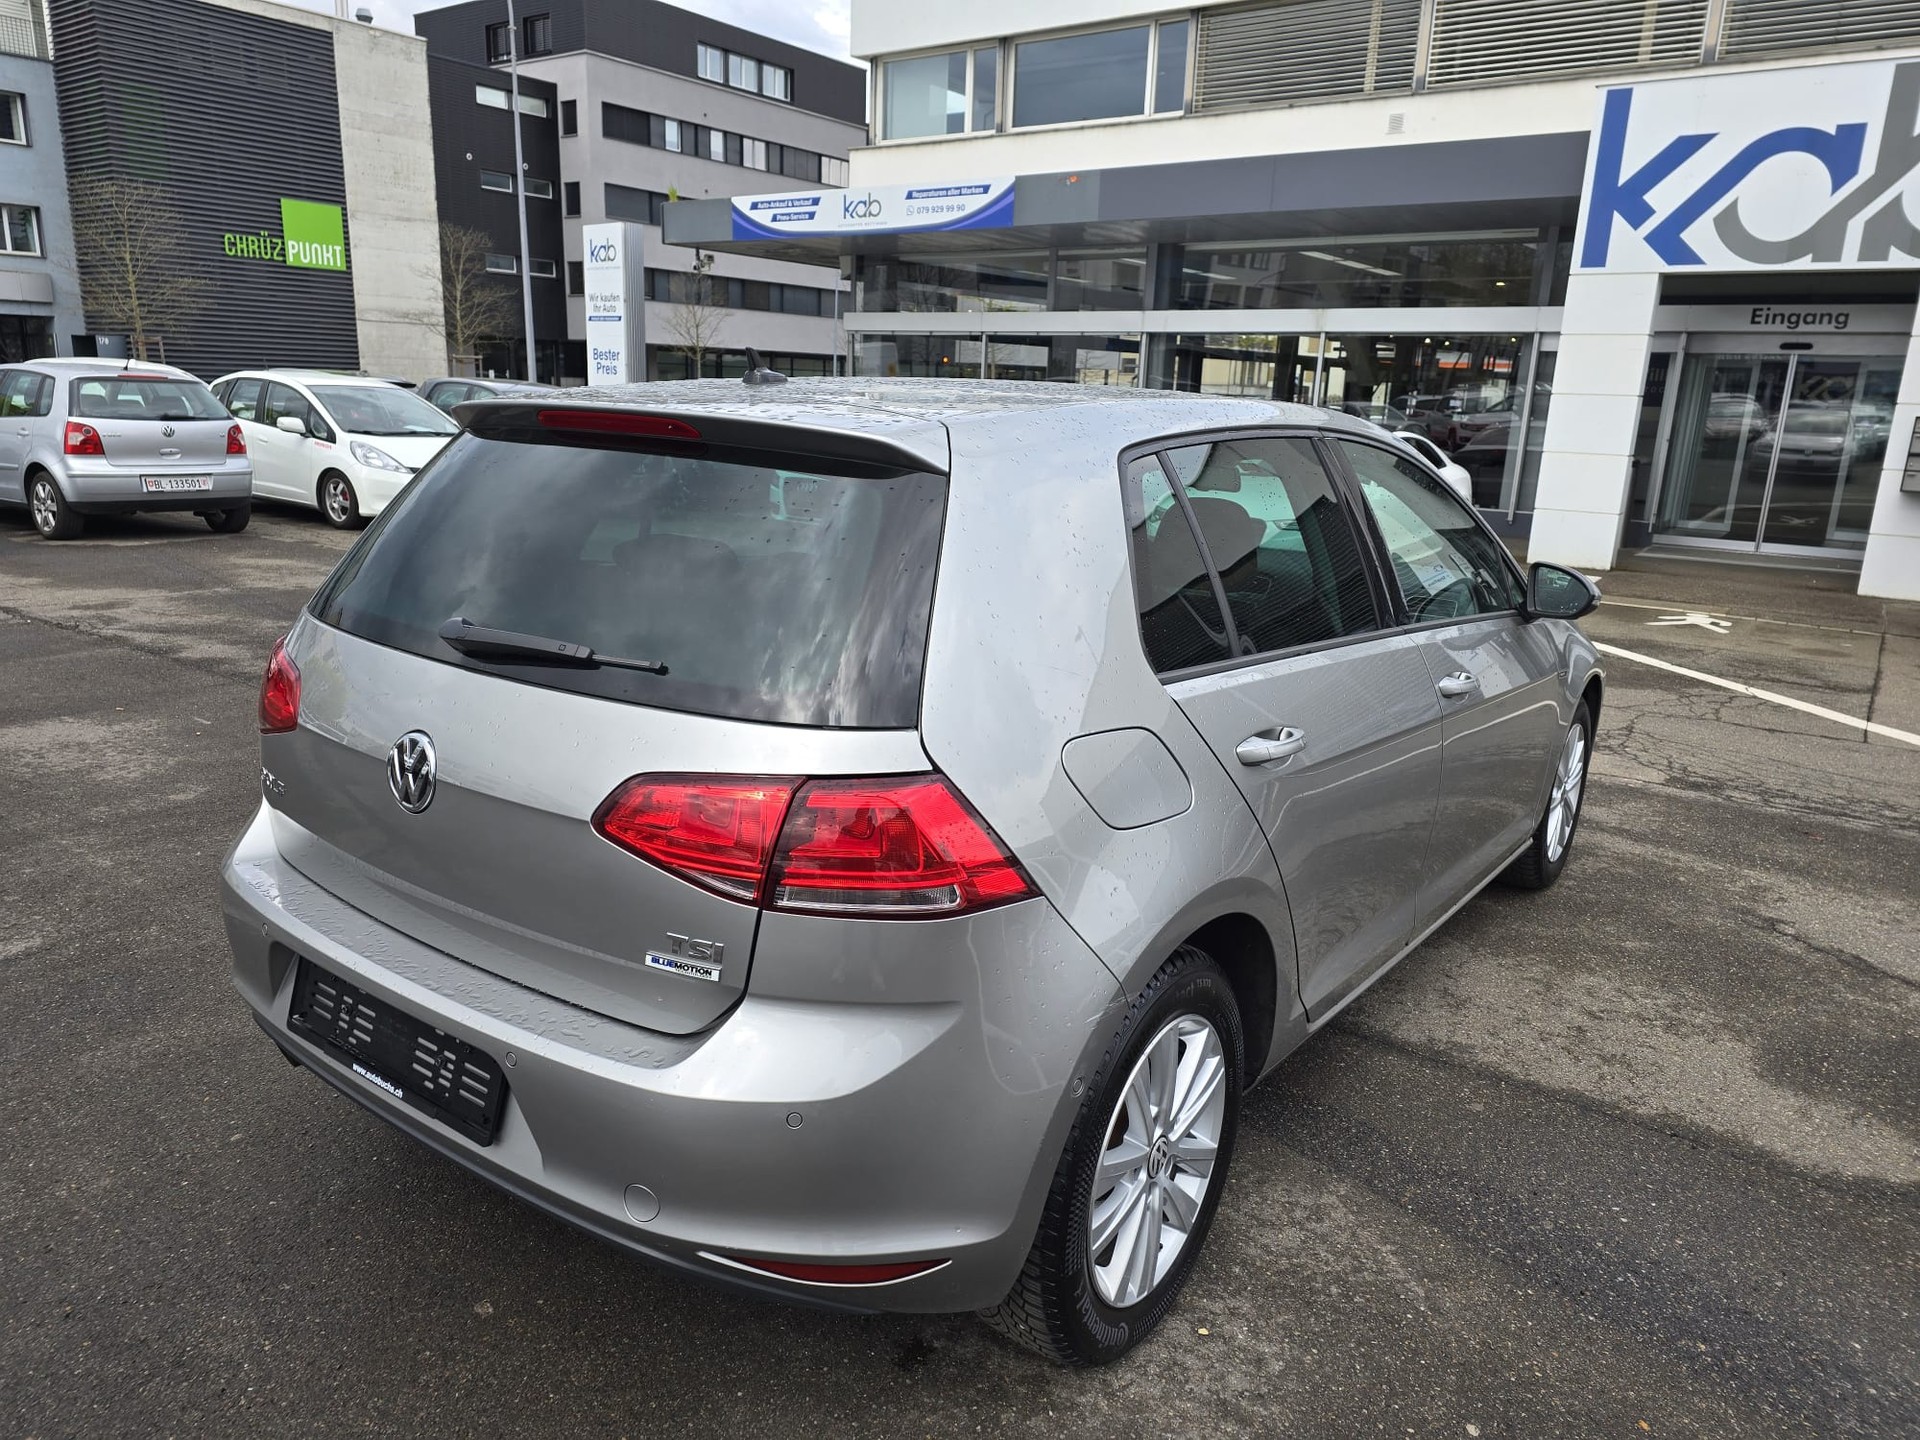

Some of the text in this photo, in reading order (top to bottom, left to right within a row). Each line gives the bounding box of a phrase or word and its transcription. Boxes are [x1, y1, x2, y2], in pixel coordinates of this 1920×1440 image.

[843, 192, 882, 220] kab
[917, 203, 966, 214] 079 929 99 90
[224, 231, 341, 267] CHRÜZ PUNKT
[590, 238, 617, 263] kab
[589, 292, 620, 302] Wir kaufen
[593, 303, 616, 313] Ihr Auto
[1750, 307, 1849, 329] Eingang
[593, 348, 620, 361] Bester
[597, 362, 617, 375] Preis
[666, 932, 724, 963] TSI
[650, 955, 713, 977] BLUEMOTION
[352, 1062, 404, 1099] www.autobuchs.ch
[1076, 1291, 1128, 1348] Continental
